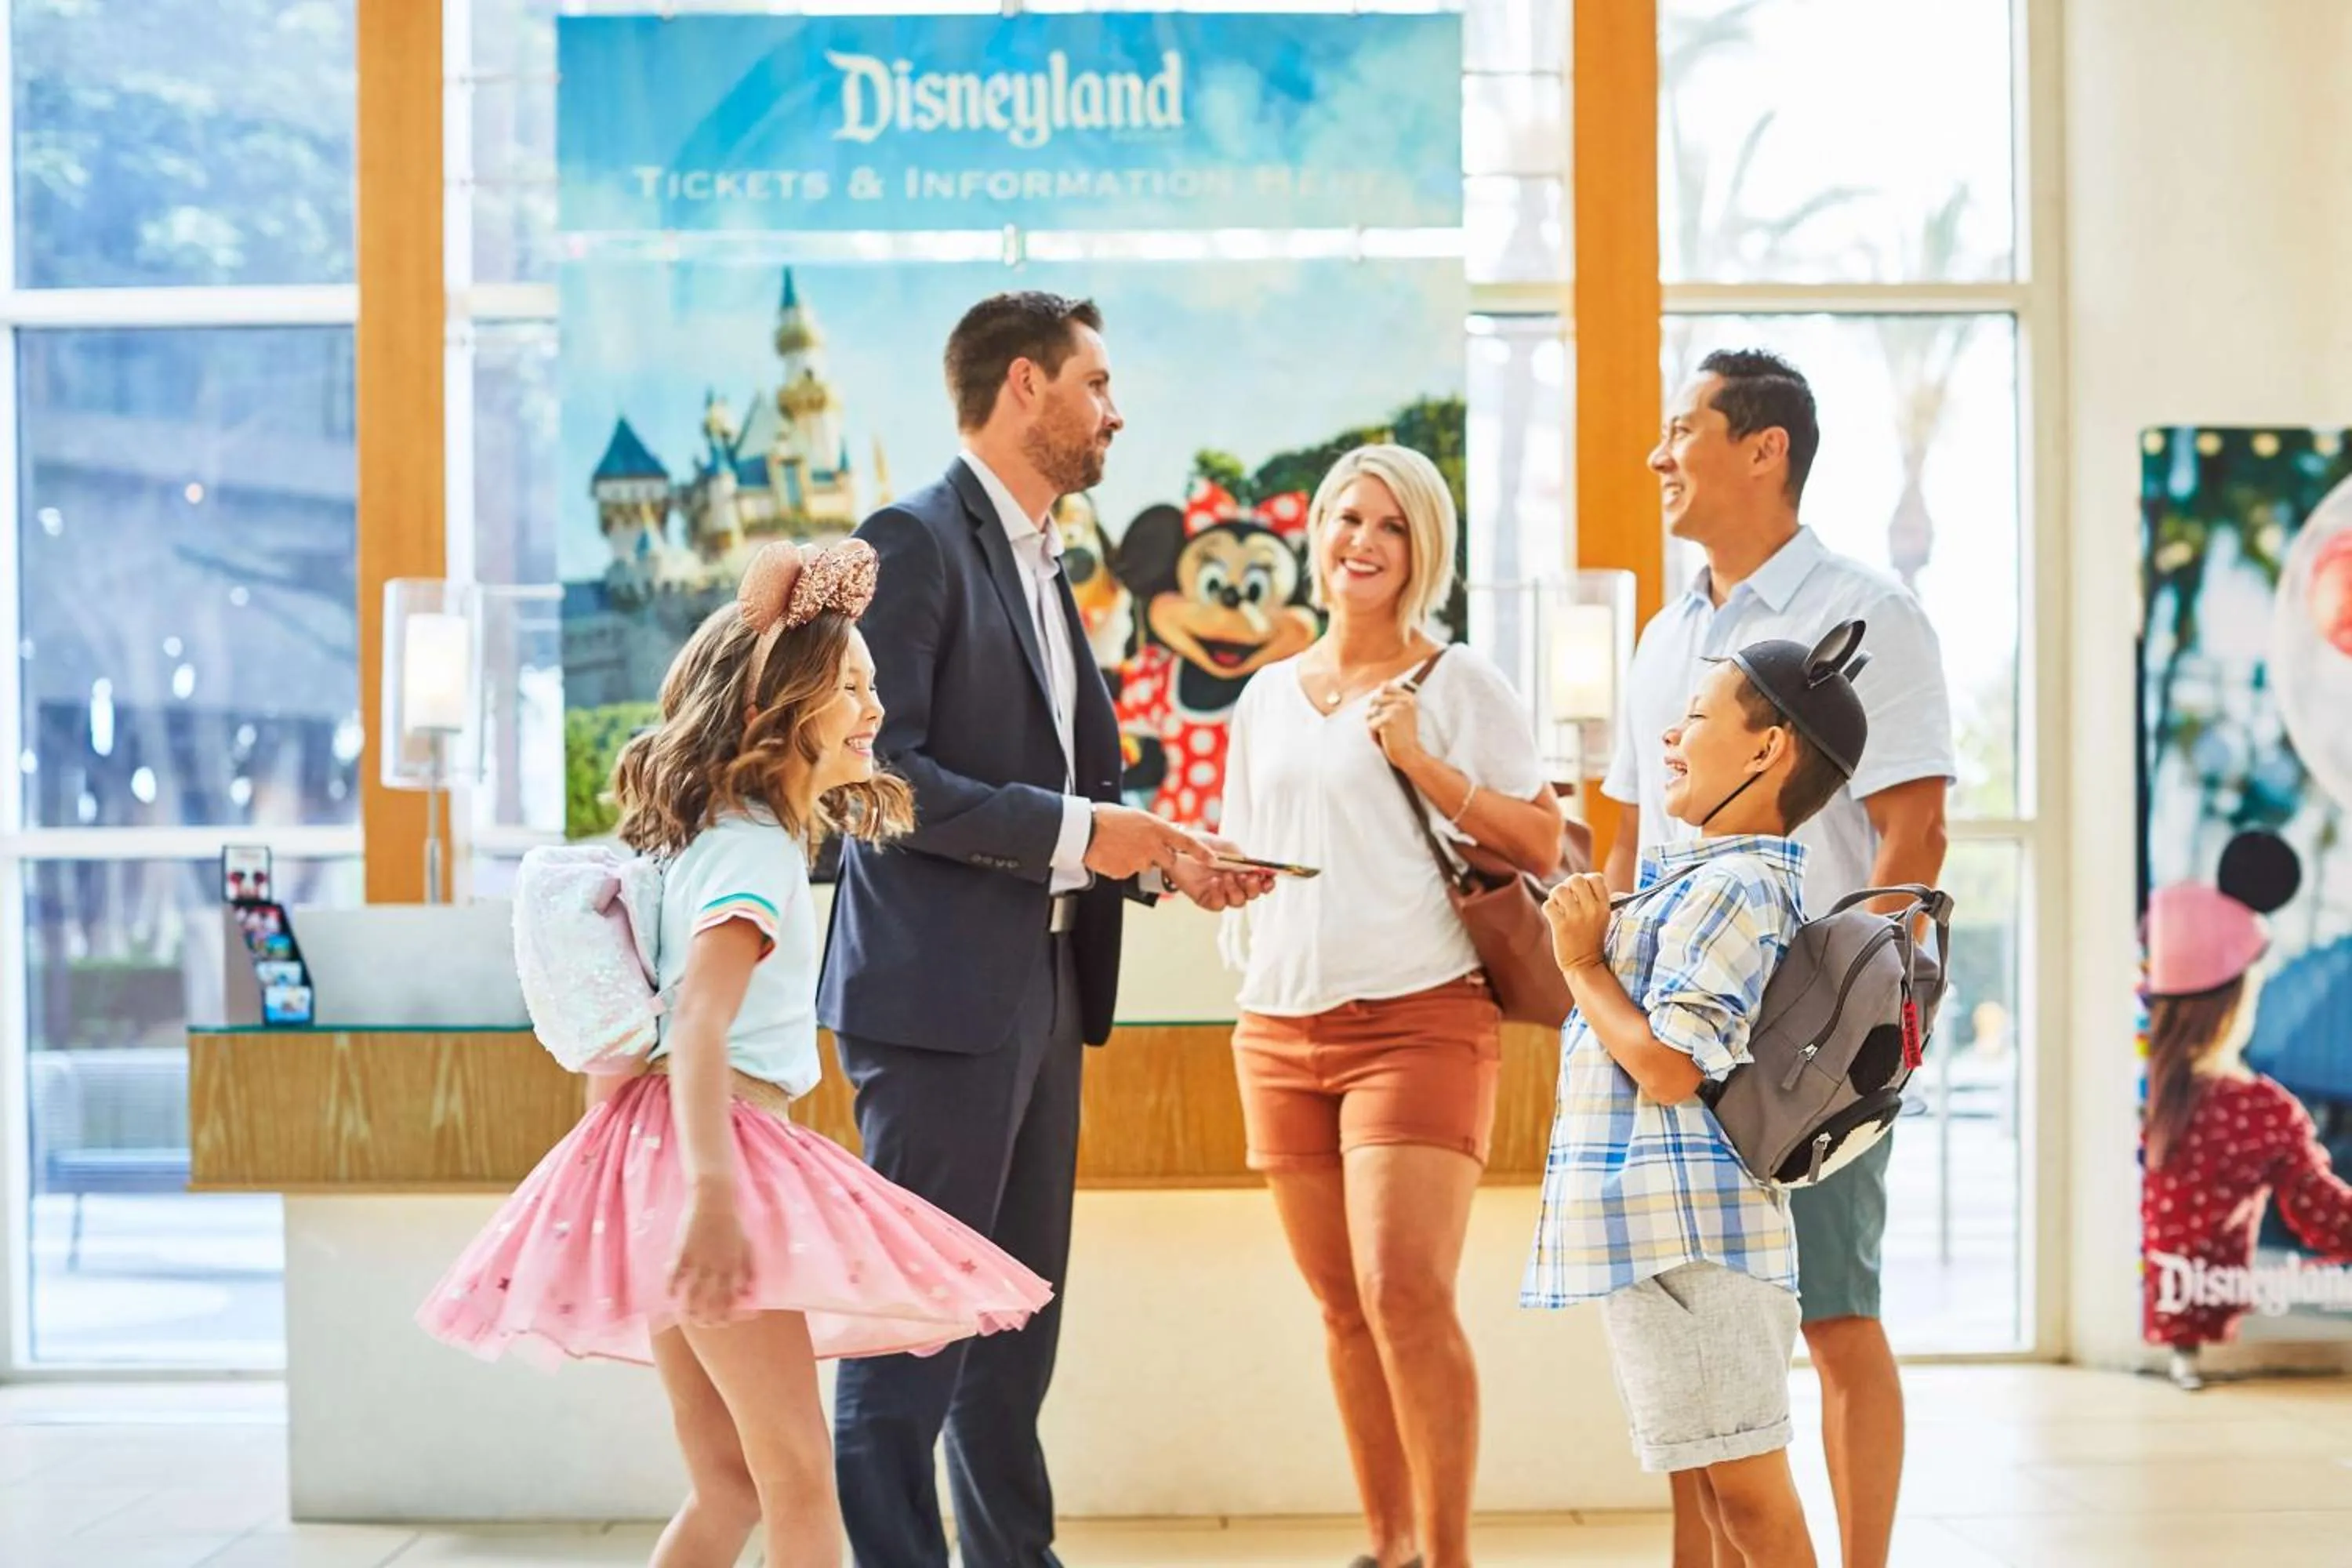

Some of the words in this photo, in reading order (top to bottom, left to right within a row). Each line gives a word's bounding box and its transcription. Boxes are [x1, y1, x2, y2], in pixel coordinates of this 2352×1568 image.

[824, 49, 1184, 149] Disneyland
[631, 165, 829, 200] TICKETS
[847, 165, 886, 200] &
[904, 164, 1234, 199] INFORMATION
